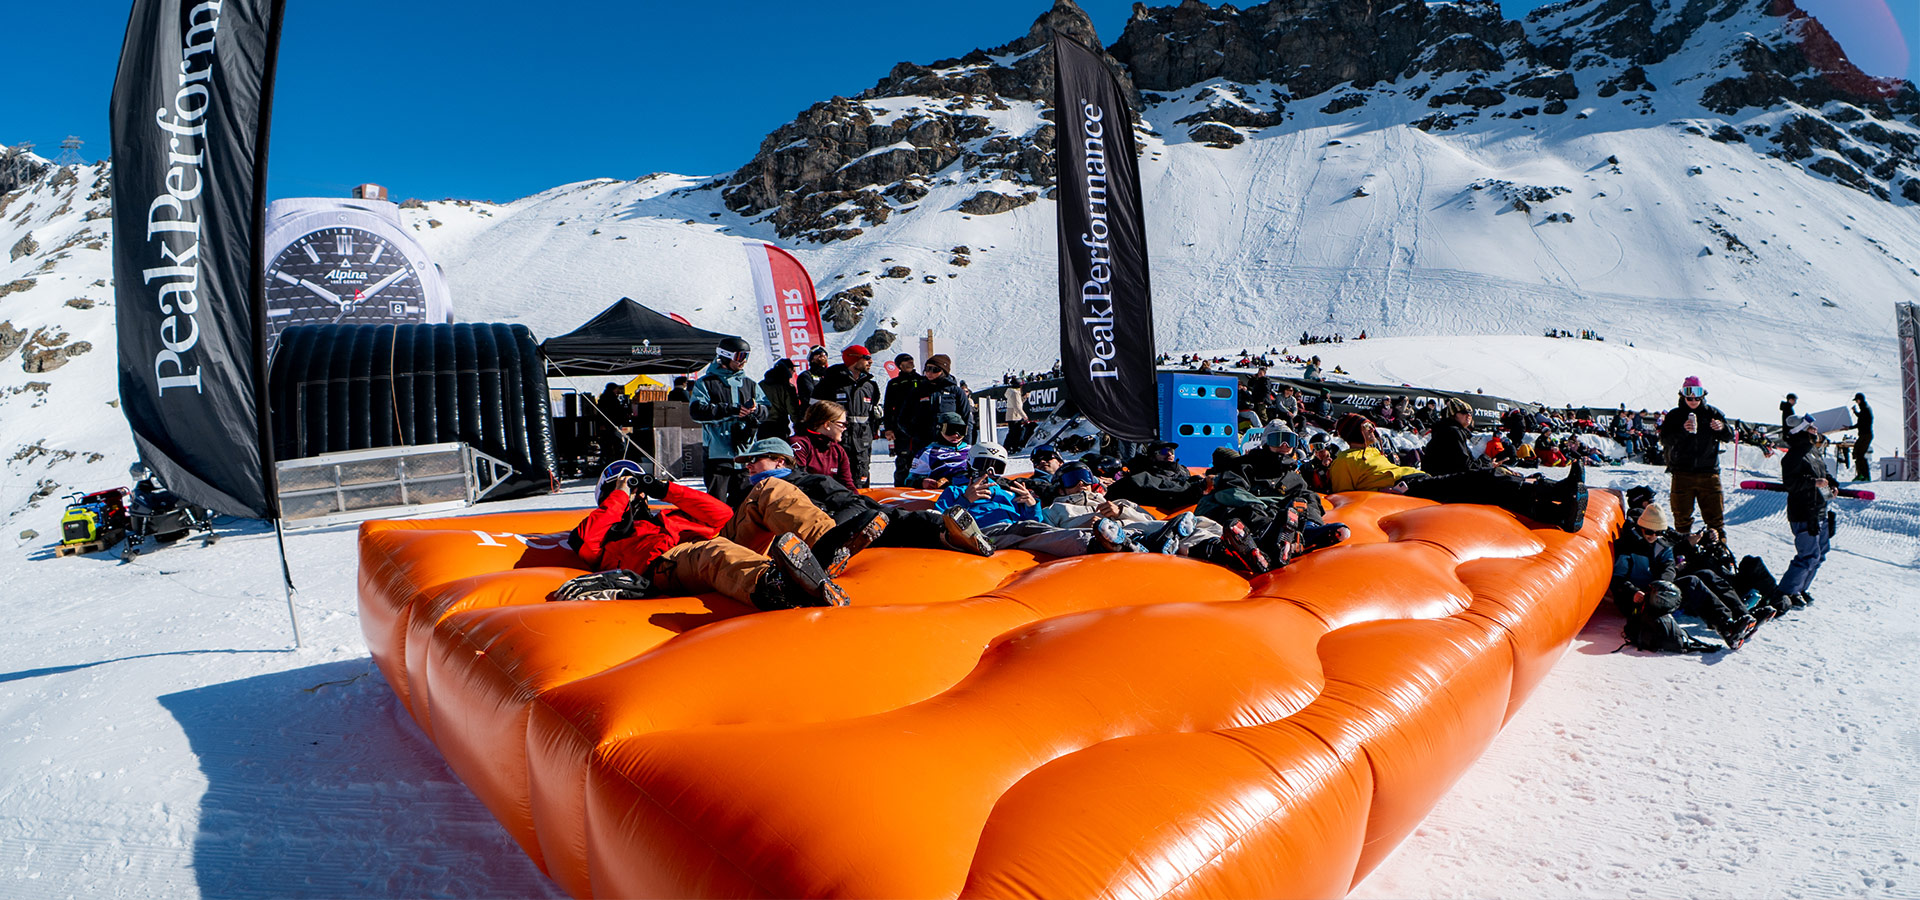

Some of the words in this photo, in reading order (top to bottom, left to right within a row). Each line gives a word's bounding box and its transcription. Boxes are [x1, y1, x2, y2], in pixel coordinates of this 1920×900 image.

[324, 269, 368, 281] Alpina
[394, 304, 402, 314] 8
[1475, 408, 1501, 418] XTREME
